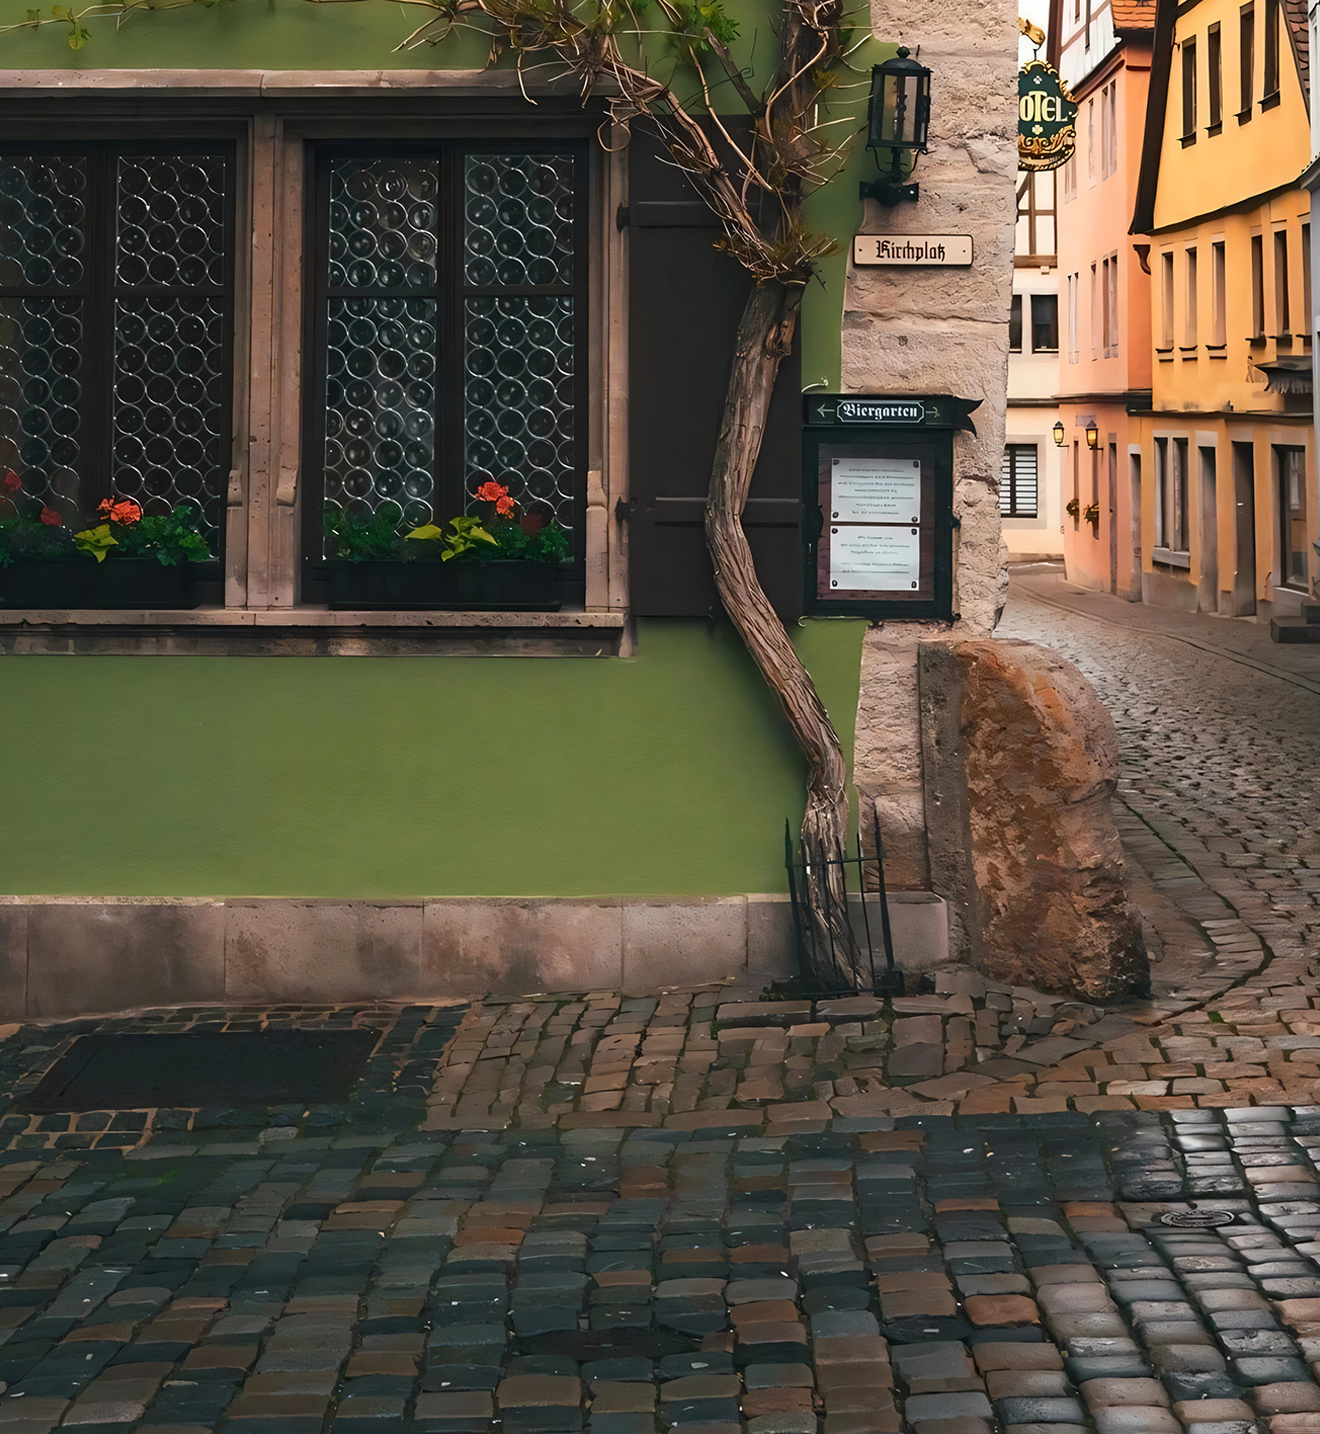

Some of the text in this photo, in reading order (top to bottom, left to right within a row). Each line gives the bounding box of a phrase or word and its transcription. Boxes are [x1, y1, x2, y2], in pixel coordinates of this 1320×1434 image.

[1019, 90, 1068, 122] OTEL
[875, 240, 946, 262] Kirchplatz
[842, 403, 918, 420] Biergarten
